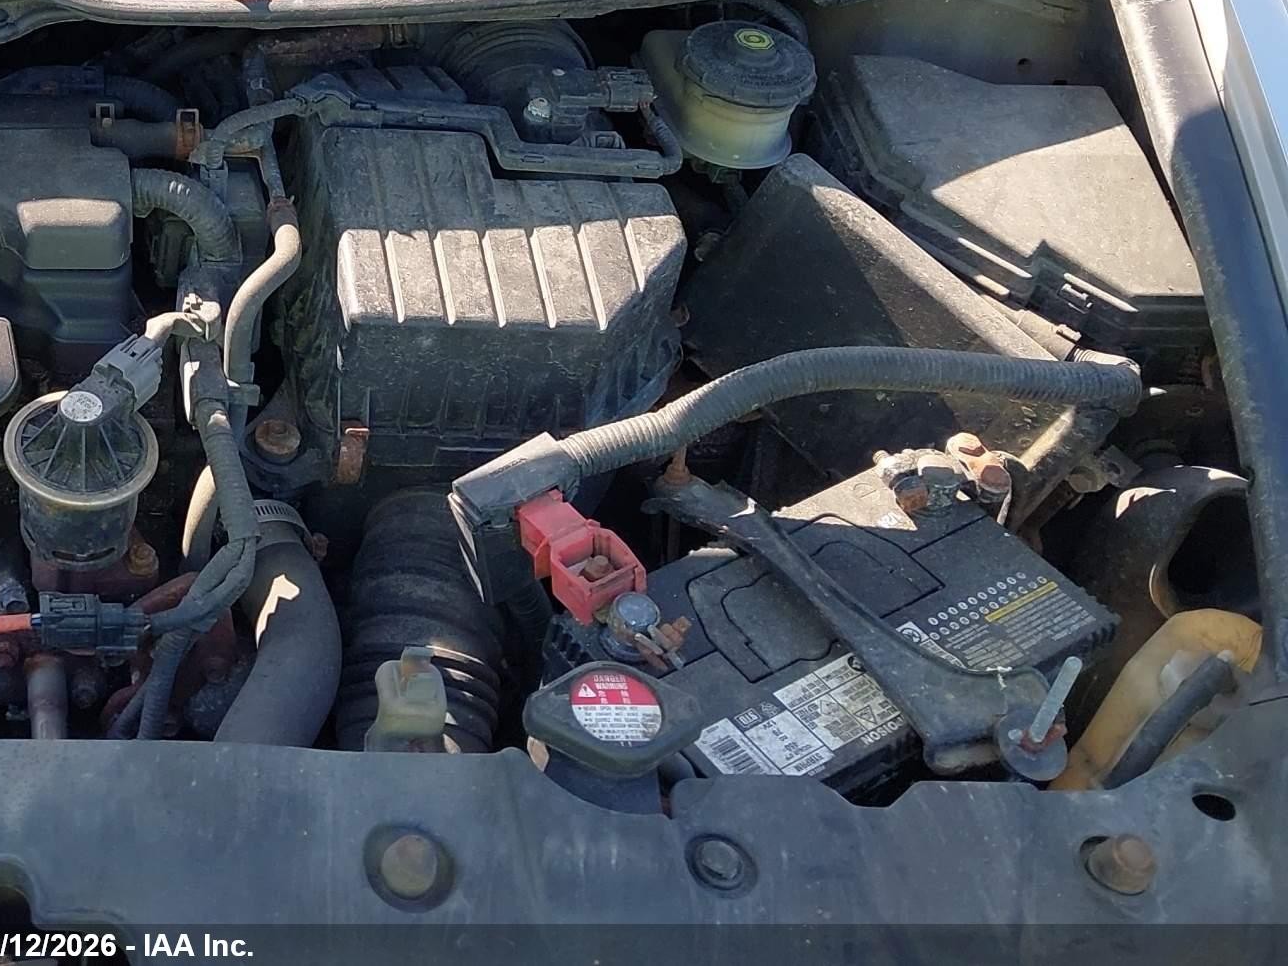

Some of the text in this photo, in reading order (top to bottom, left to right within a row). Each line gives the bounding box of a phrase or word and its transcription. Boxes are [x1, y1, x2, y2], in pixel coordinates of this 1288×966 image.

[593, 674, 627, 683] DANGER
[595, 682, 629, 690] WARNING
[862, 716, 905, 746] POISON
